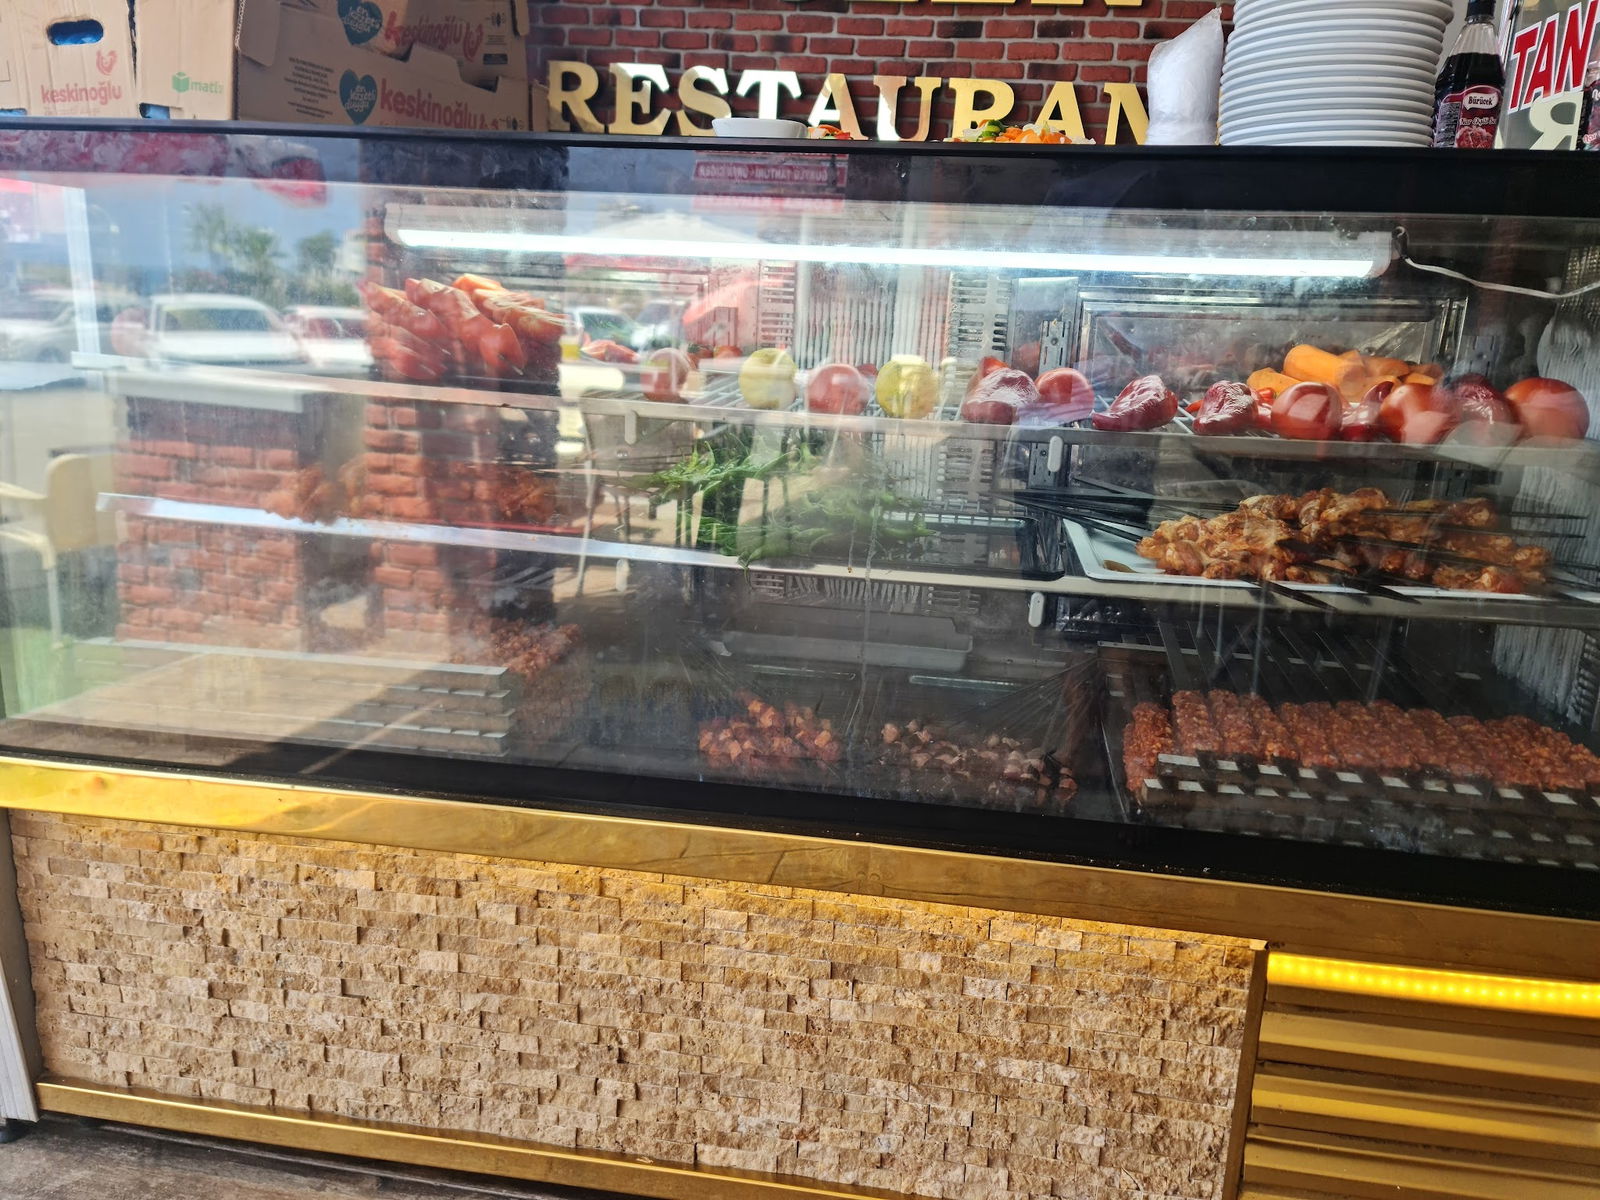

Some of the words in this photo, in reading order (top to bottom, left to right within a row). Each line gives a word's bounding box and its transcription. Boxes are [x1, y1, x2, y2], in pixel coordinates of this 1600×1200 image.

[1507, 0, 1600, 114] TAN
[41, 81, 122, 106] keskinoğlu
[380, 78, 478, 129] keskinoğlu
[549, 60, 1151, 146] RESTAURAN
[1468, 95, 1493, 106] Bürücek
